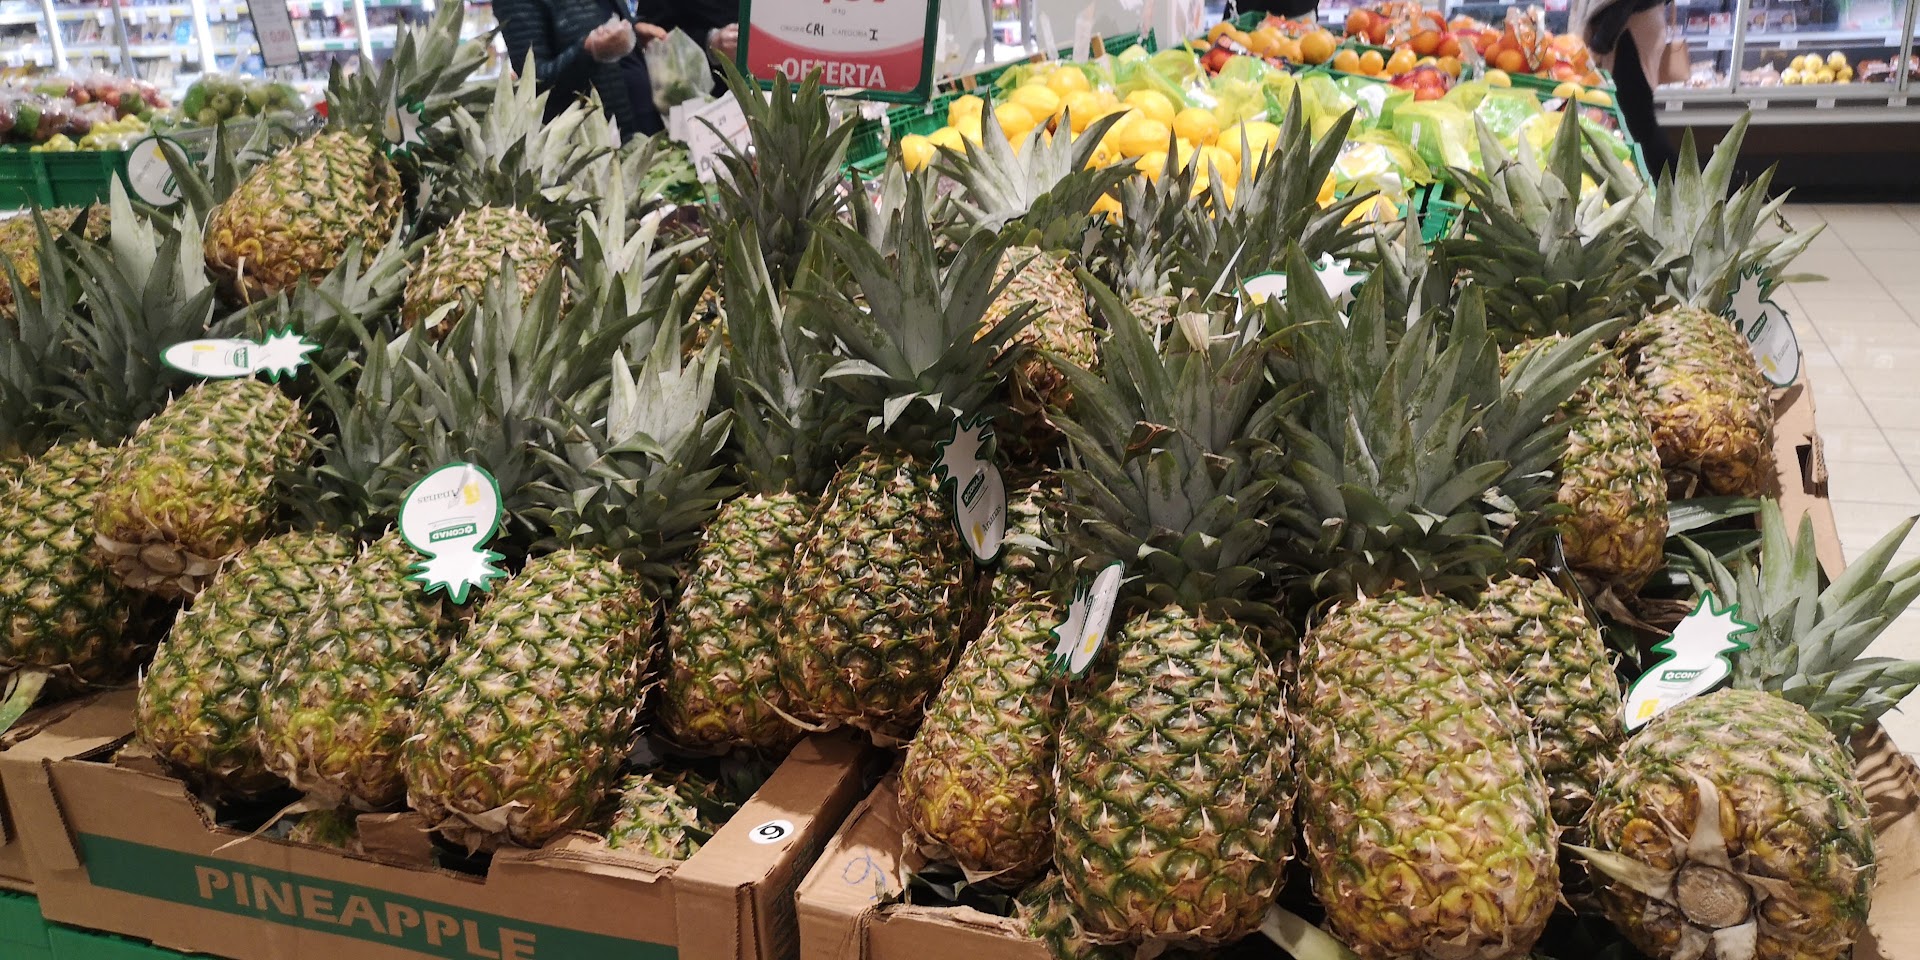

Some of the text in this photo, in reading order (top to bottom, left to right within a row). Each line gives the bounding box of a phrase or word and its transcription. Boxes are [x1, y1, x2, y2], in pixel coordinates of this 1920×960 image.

[805, 22, 825, 37] CRI
[782, 57, 886, 88] OFFERTA
[418, 488, 460, 504] Ananas
[432, 529, 465, 540] CONAD
[194, 865, 536, 960] PINEAPPLE
